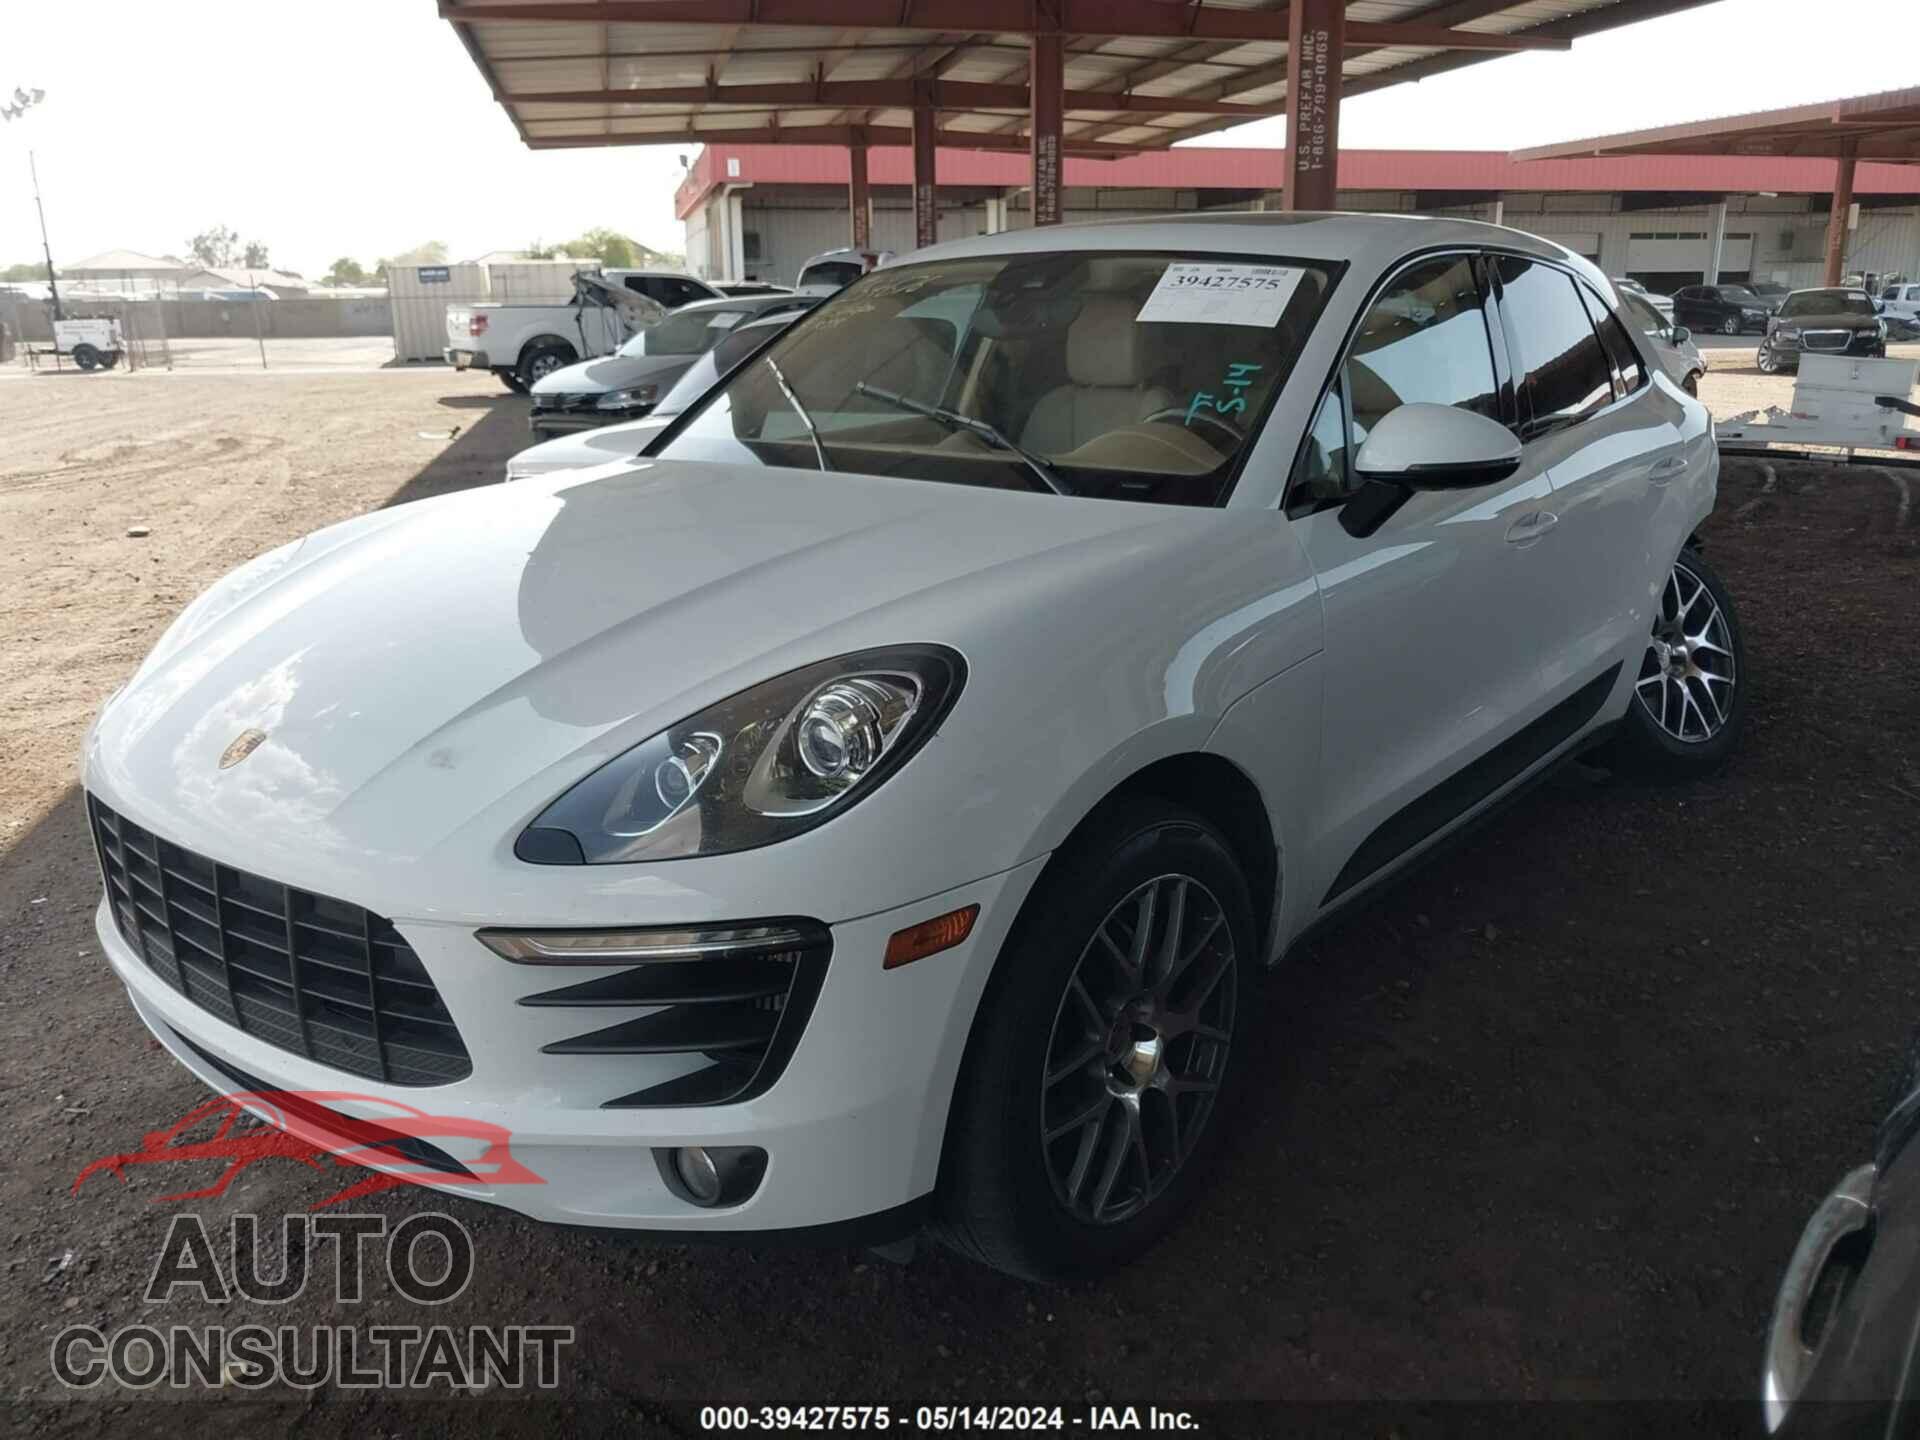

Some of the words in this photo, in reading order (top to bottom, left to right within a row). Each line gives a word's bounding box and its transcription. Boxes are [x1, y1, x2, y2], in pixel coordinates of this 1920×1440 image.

[1302, 30, 1315, 61] INC.
[1300, 69, 1313, 132] PREFAB
[1298, 140, 1311, 171] U.S.
[1169, 275, 1281, 290] 39427575
